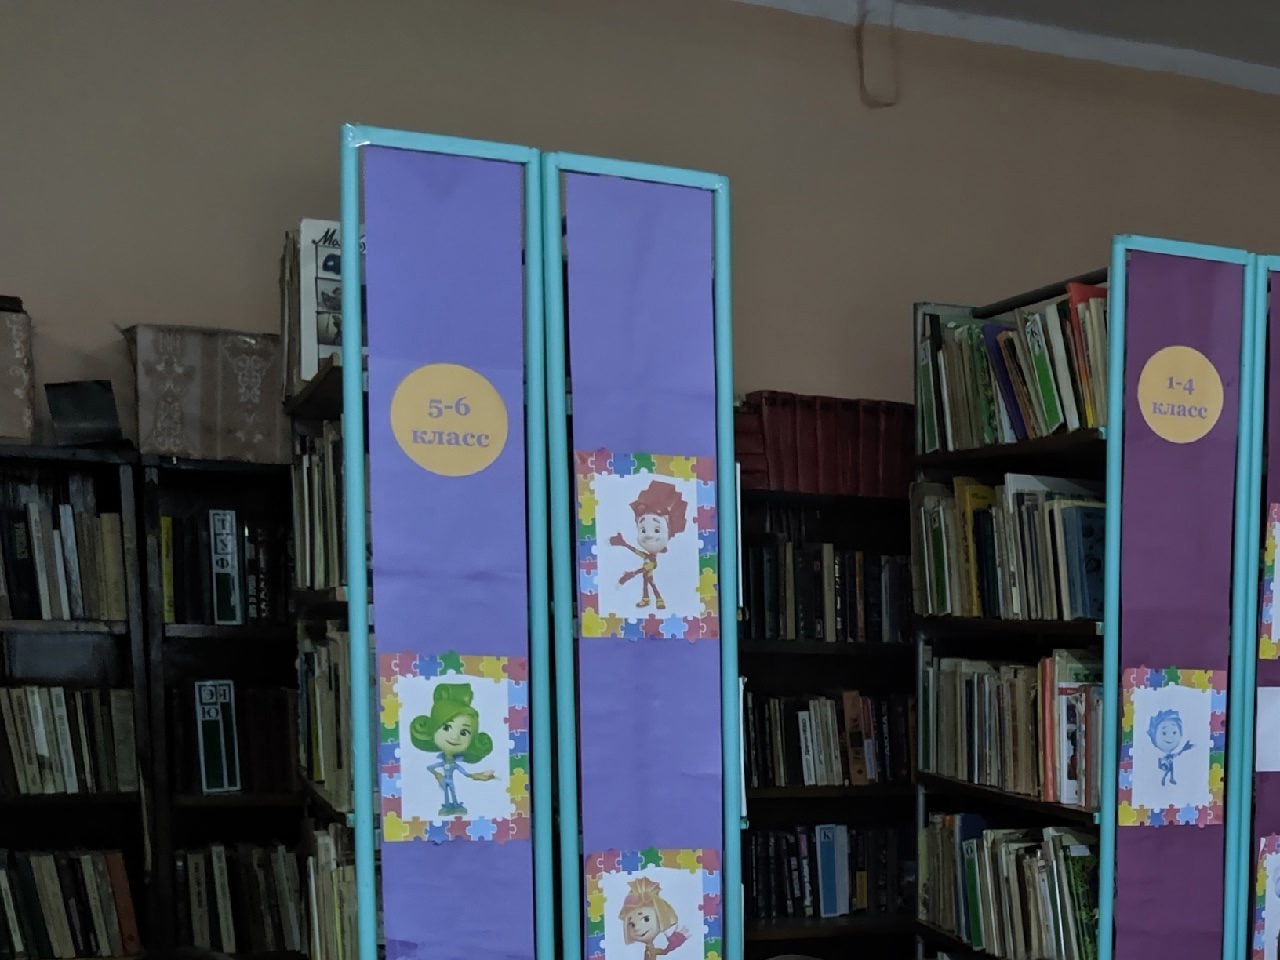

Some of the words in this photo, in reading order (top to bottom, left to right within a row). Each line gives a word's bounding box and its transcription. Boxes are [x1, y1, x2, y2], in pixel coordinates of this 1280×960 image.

[1167, 375, 1195, 395] 1-4
[427, 397, 471, 419] 5-6
[1151, 402, 1208, 420] класс
[411, 428, 490, 448] класс
